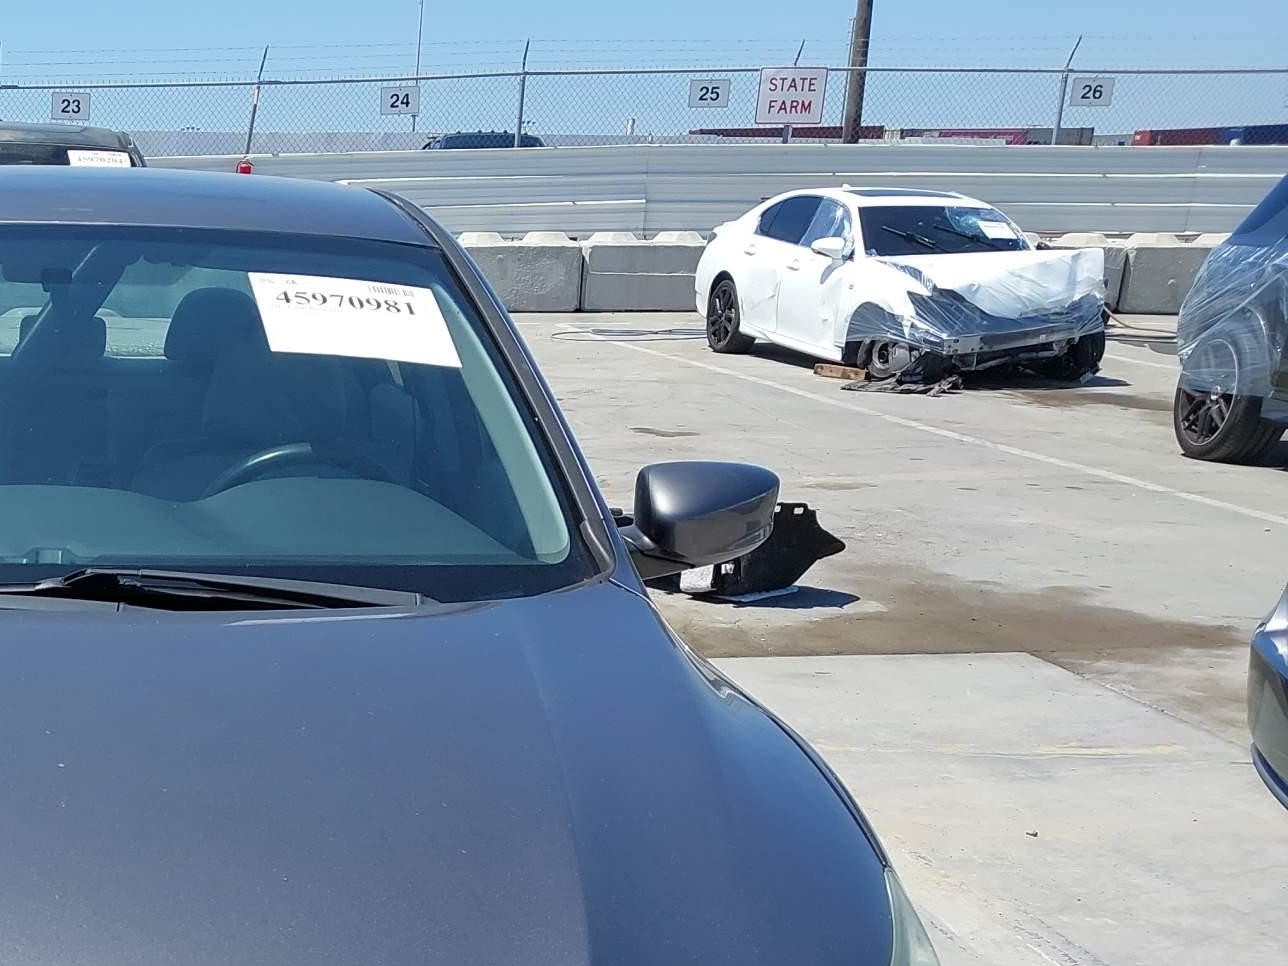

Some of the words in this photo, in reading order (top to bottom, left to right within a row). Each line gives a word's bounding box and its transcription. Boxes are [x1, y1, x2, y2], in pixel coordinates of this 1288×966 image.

[768, 77, 817, 92] STATE
[1080, 84, 1104, 100] 26
[389, 93, 410, 108] 24
[698, 86, 721, 102] 25
[60, 98, 81, 114] 23
[767, 100, 812, 114] FARM
[275, 290, 416, 316] 45970981
